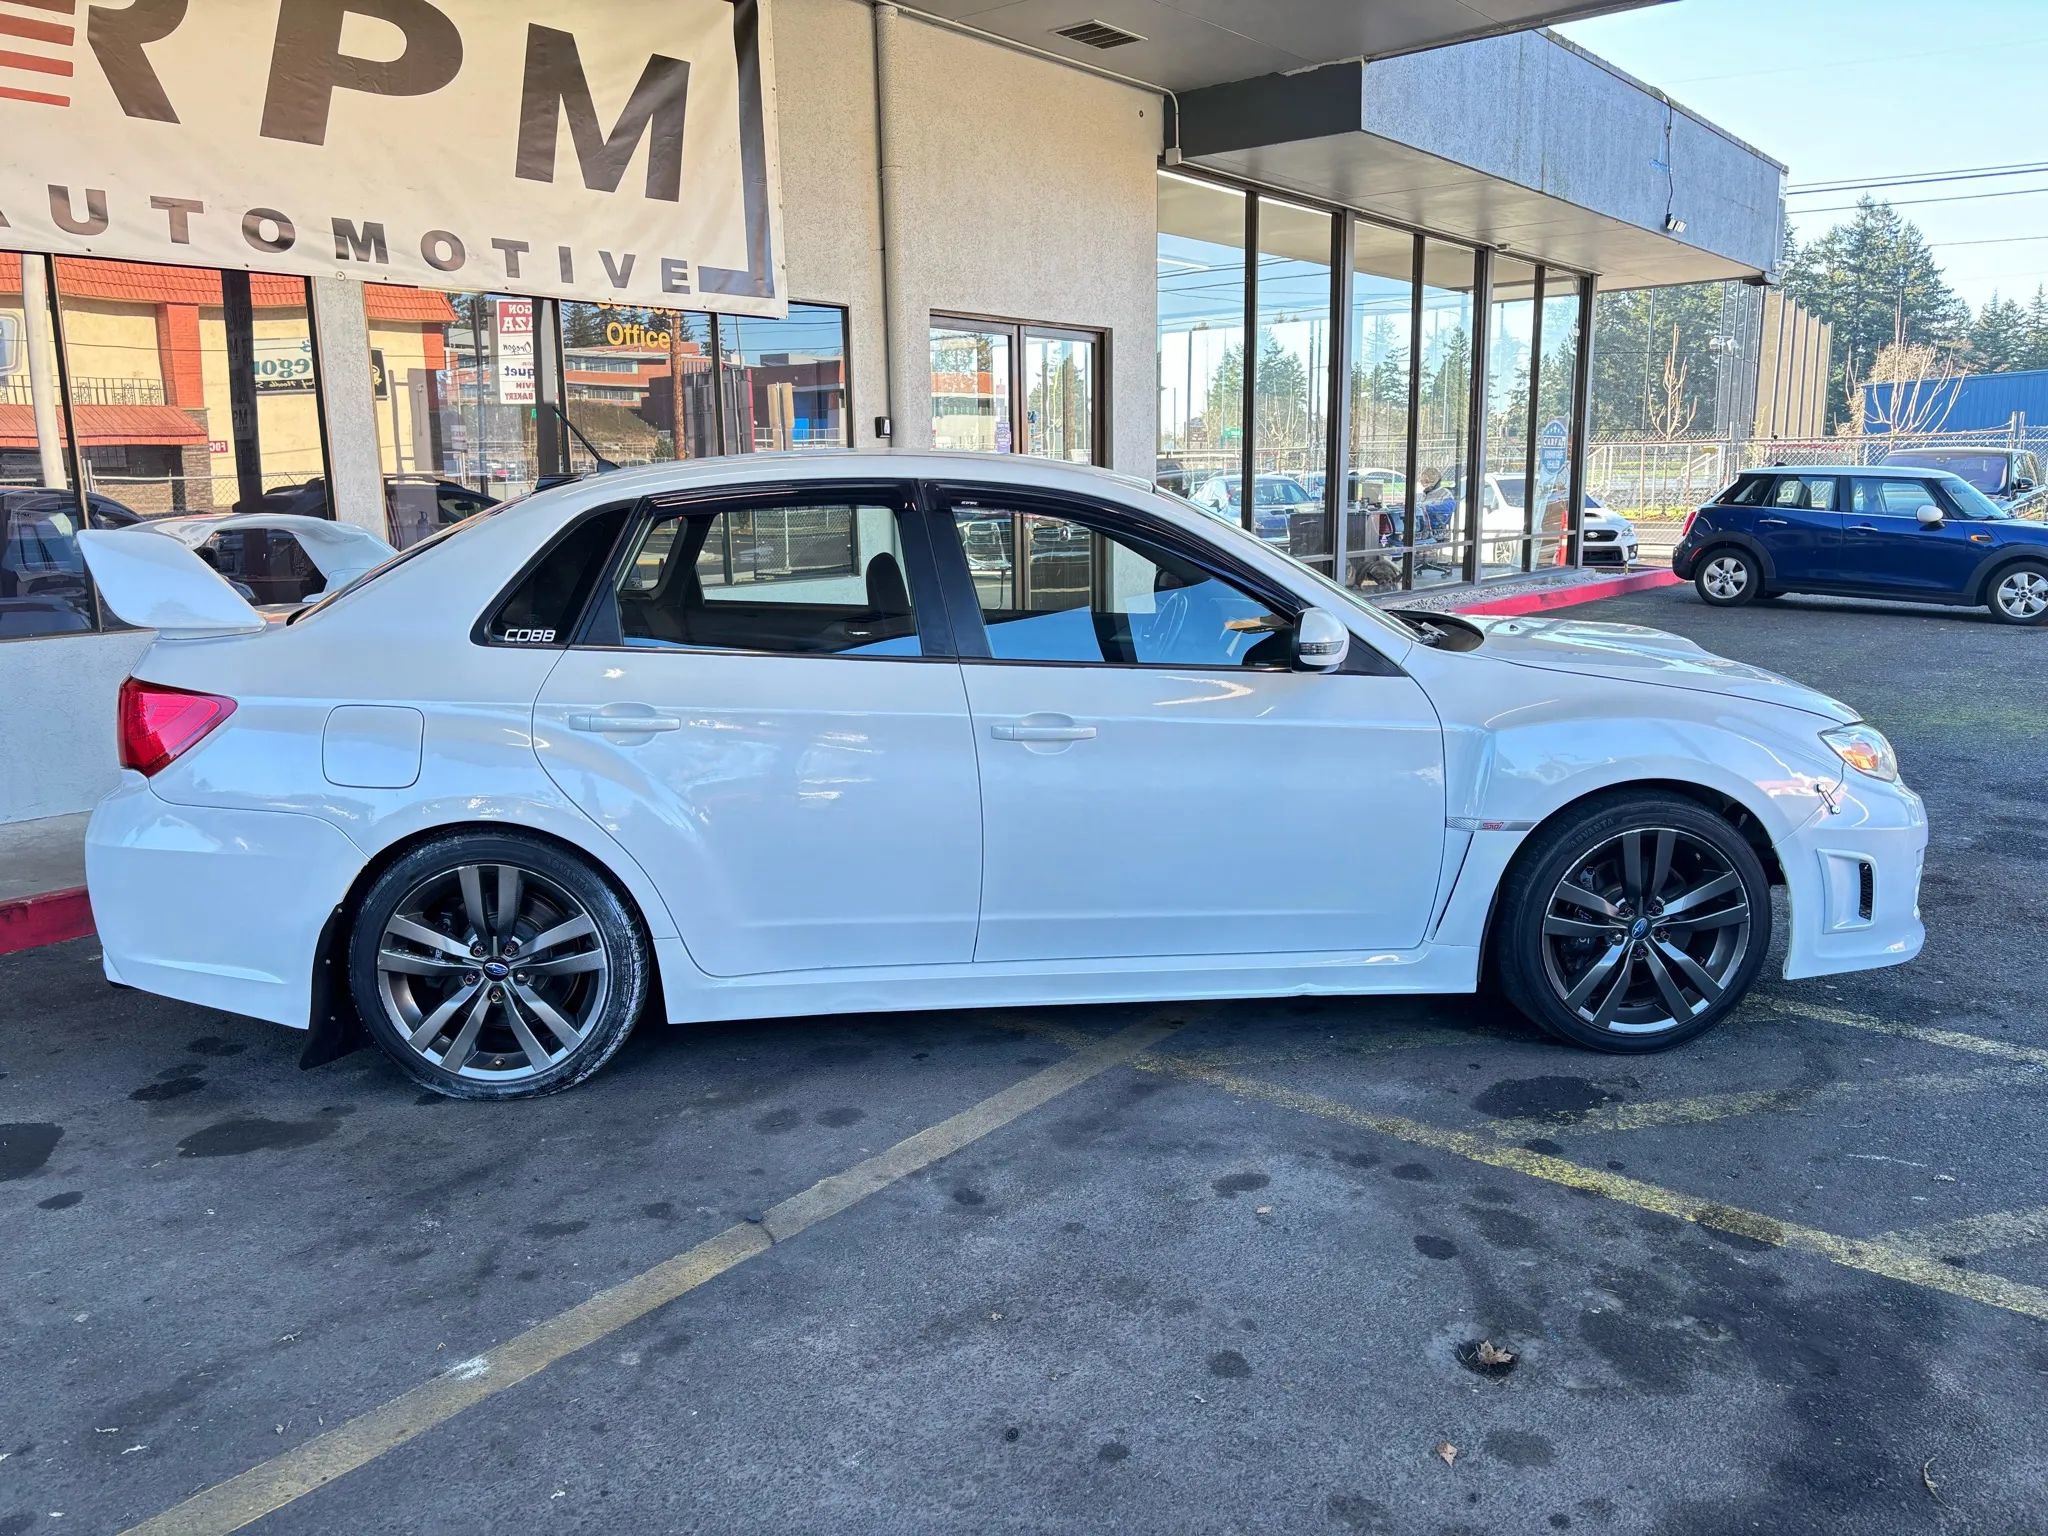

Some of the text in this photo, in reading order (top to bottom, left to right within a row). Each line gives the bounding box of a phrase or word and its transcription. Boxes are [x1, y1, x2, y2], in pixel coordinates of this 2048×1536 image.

[87, 0, 690, 202] RPM
[606, 321, 671, 349] Office
[504, 628, 556, 642] COBB
